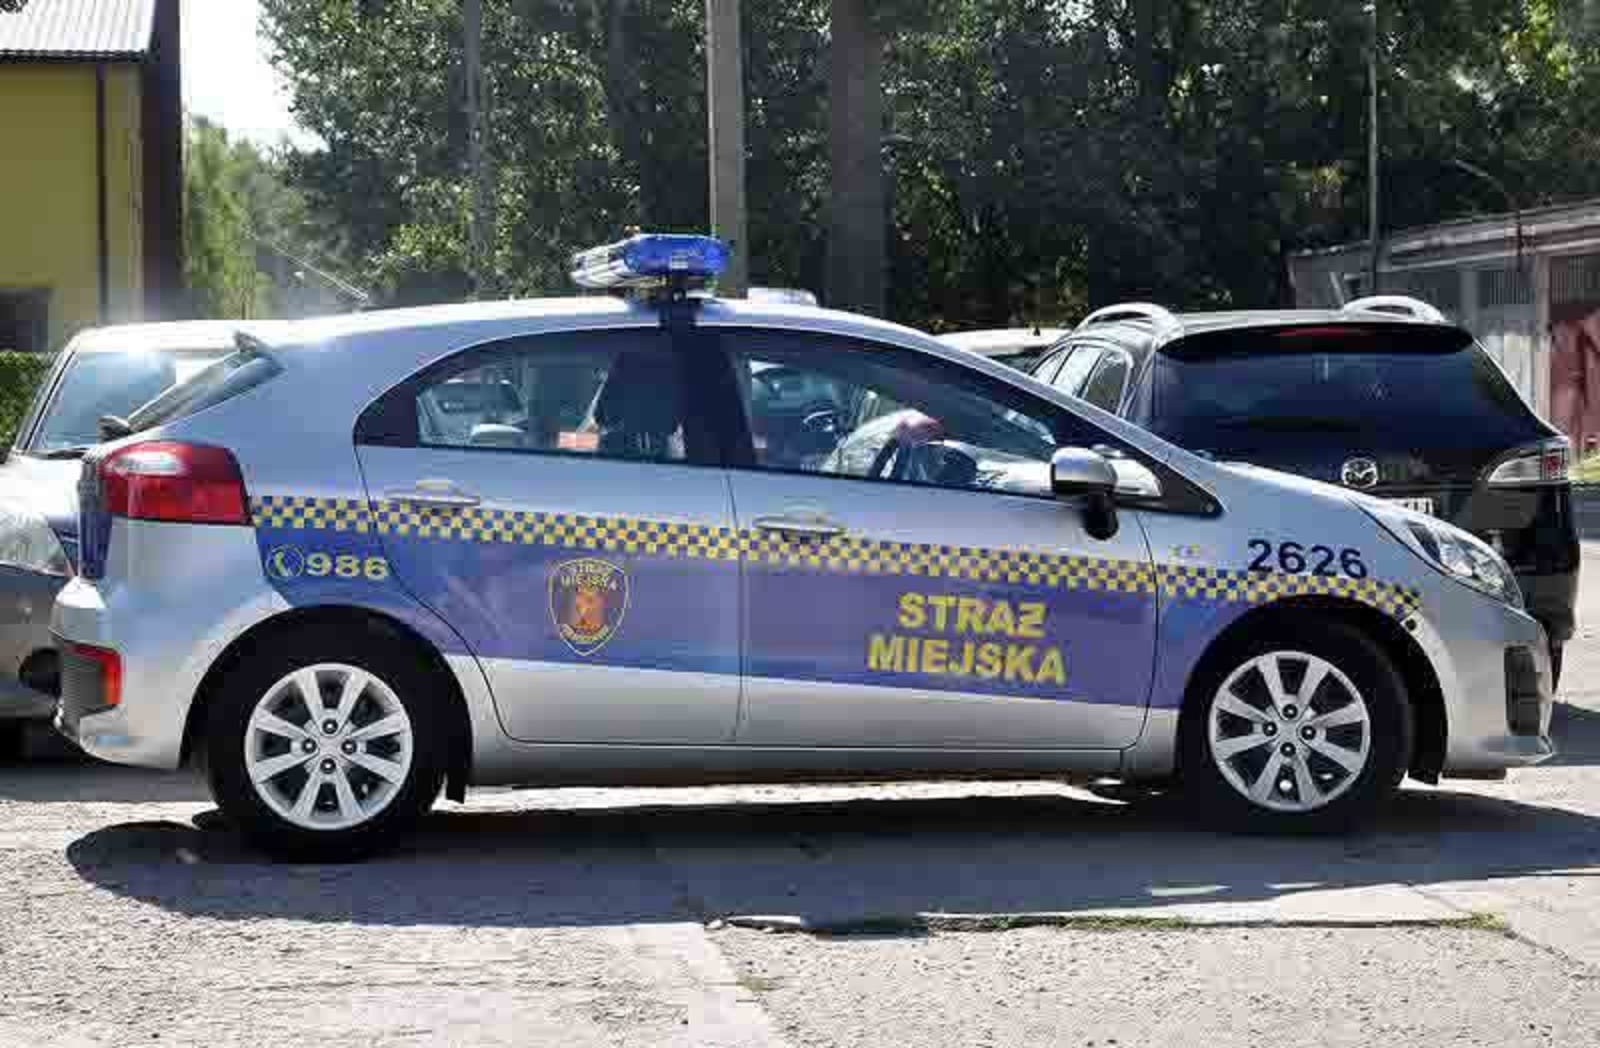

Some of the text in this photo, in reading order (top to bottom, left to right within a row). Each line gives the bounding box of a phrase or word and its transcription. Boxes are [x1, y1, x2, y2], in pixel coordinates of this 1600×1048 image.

[305, 552, 390, 580] 986
[1247, 538, 1367, 579] 2626
[867, 634, 1066, 685] MIEJSKA
